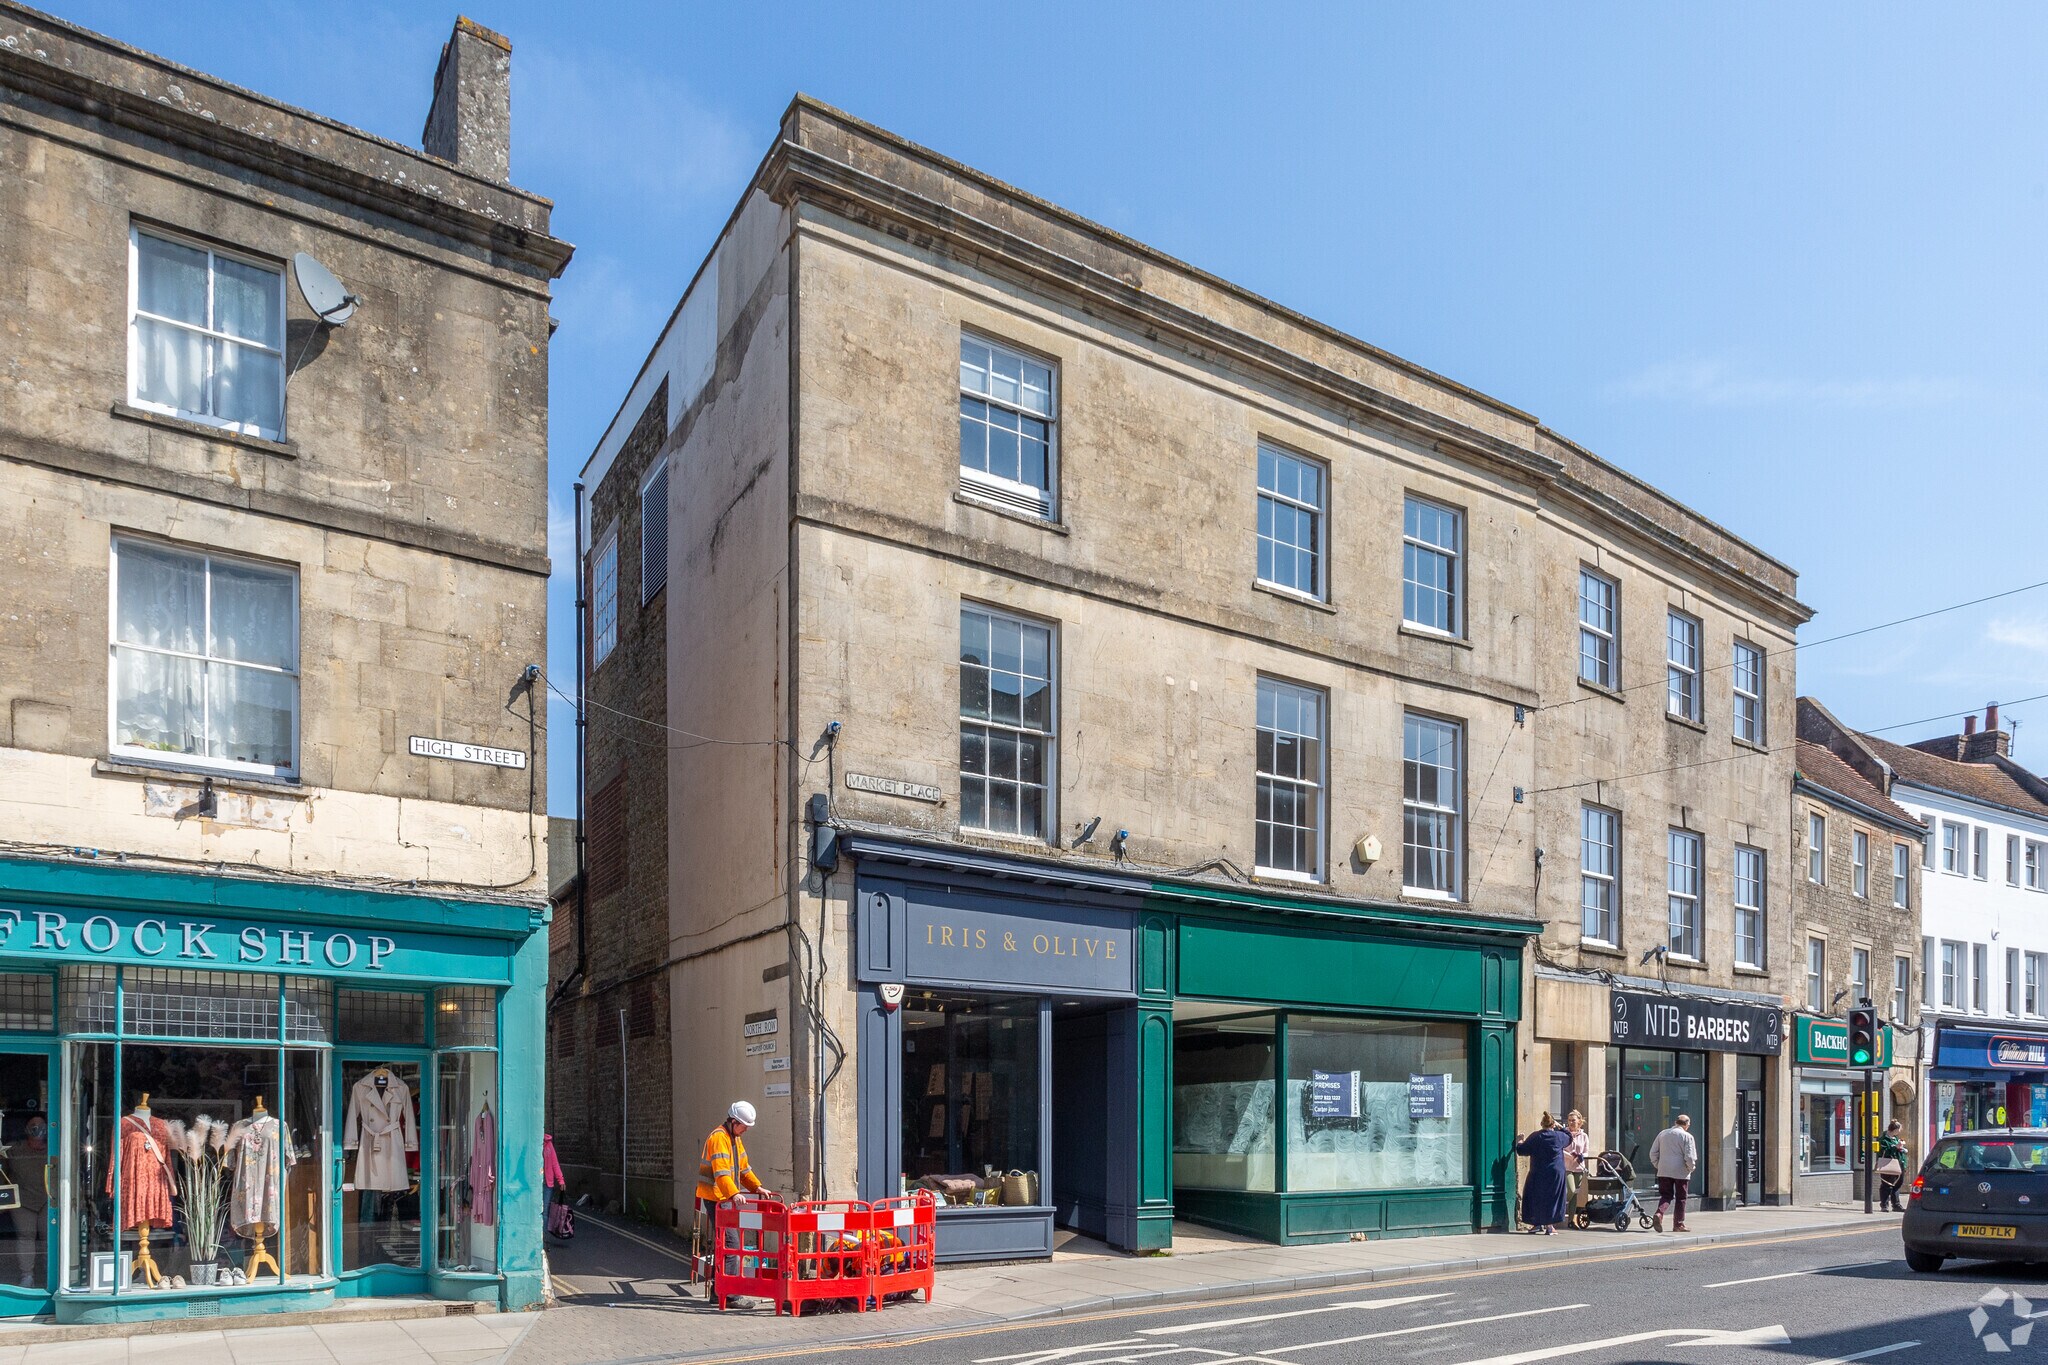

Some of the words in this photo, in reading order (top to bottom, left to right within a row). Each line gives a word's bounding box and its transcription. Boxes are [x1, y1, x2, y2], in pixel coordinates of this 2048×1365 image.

[415, 739, 453, 756] HIGH
[464, 746, 521, 765] STREET
[848, 774, 899, 794] MARKET
[903, 784, 939, 800] PLACE
[240, 926, 396, 969] SHOP
[926, 924, 987, 949] IRIS
[1003, 931, 1018, 951] &
[1033, 934, 1117, 960] OLIVE
[745, 1022, 762, 1036] NORTH
[764, 1020, 776, 1033] ROW
[1613, 1020, 1629, 1035] NTB
[1645, 1003, 1680, 1037] NTB
[1687, 1015, 1749, 1043] BARBERS
[1766, 1034, 1778, 1046] NTB
[2028, 1045, 2046, 1062] HILL
[1314, 1073, 1330, 1081] SHOP
[1962, 1226, 1987, 1236] WN10
[1990, 1227, 2012, 1237] TLK
